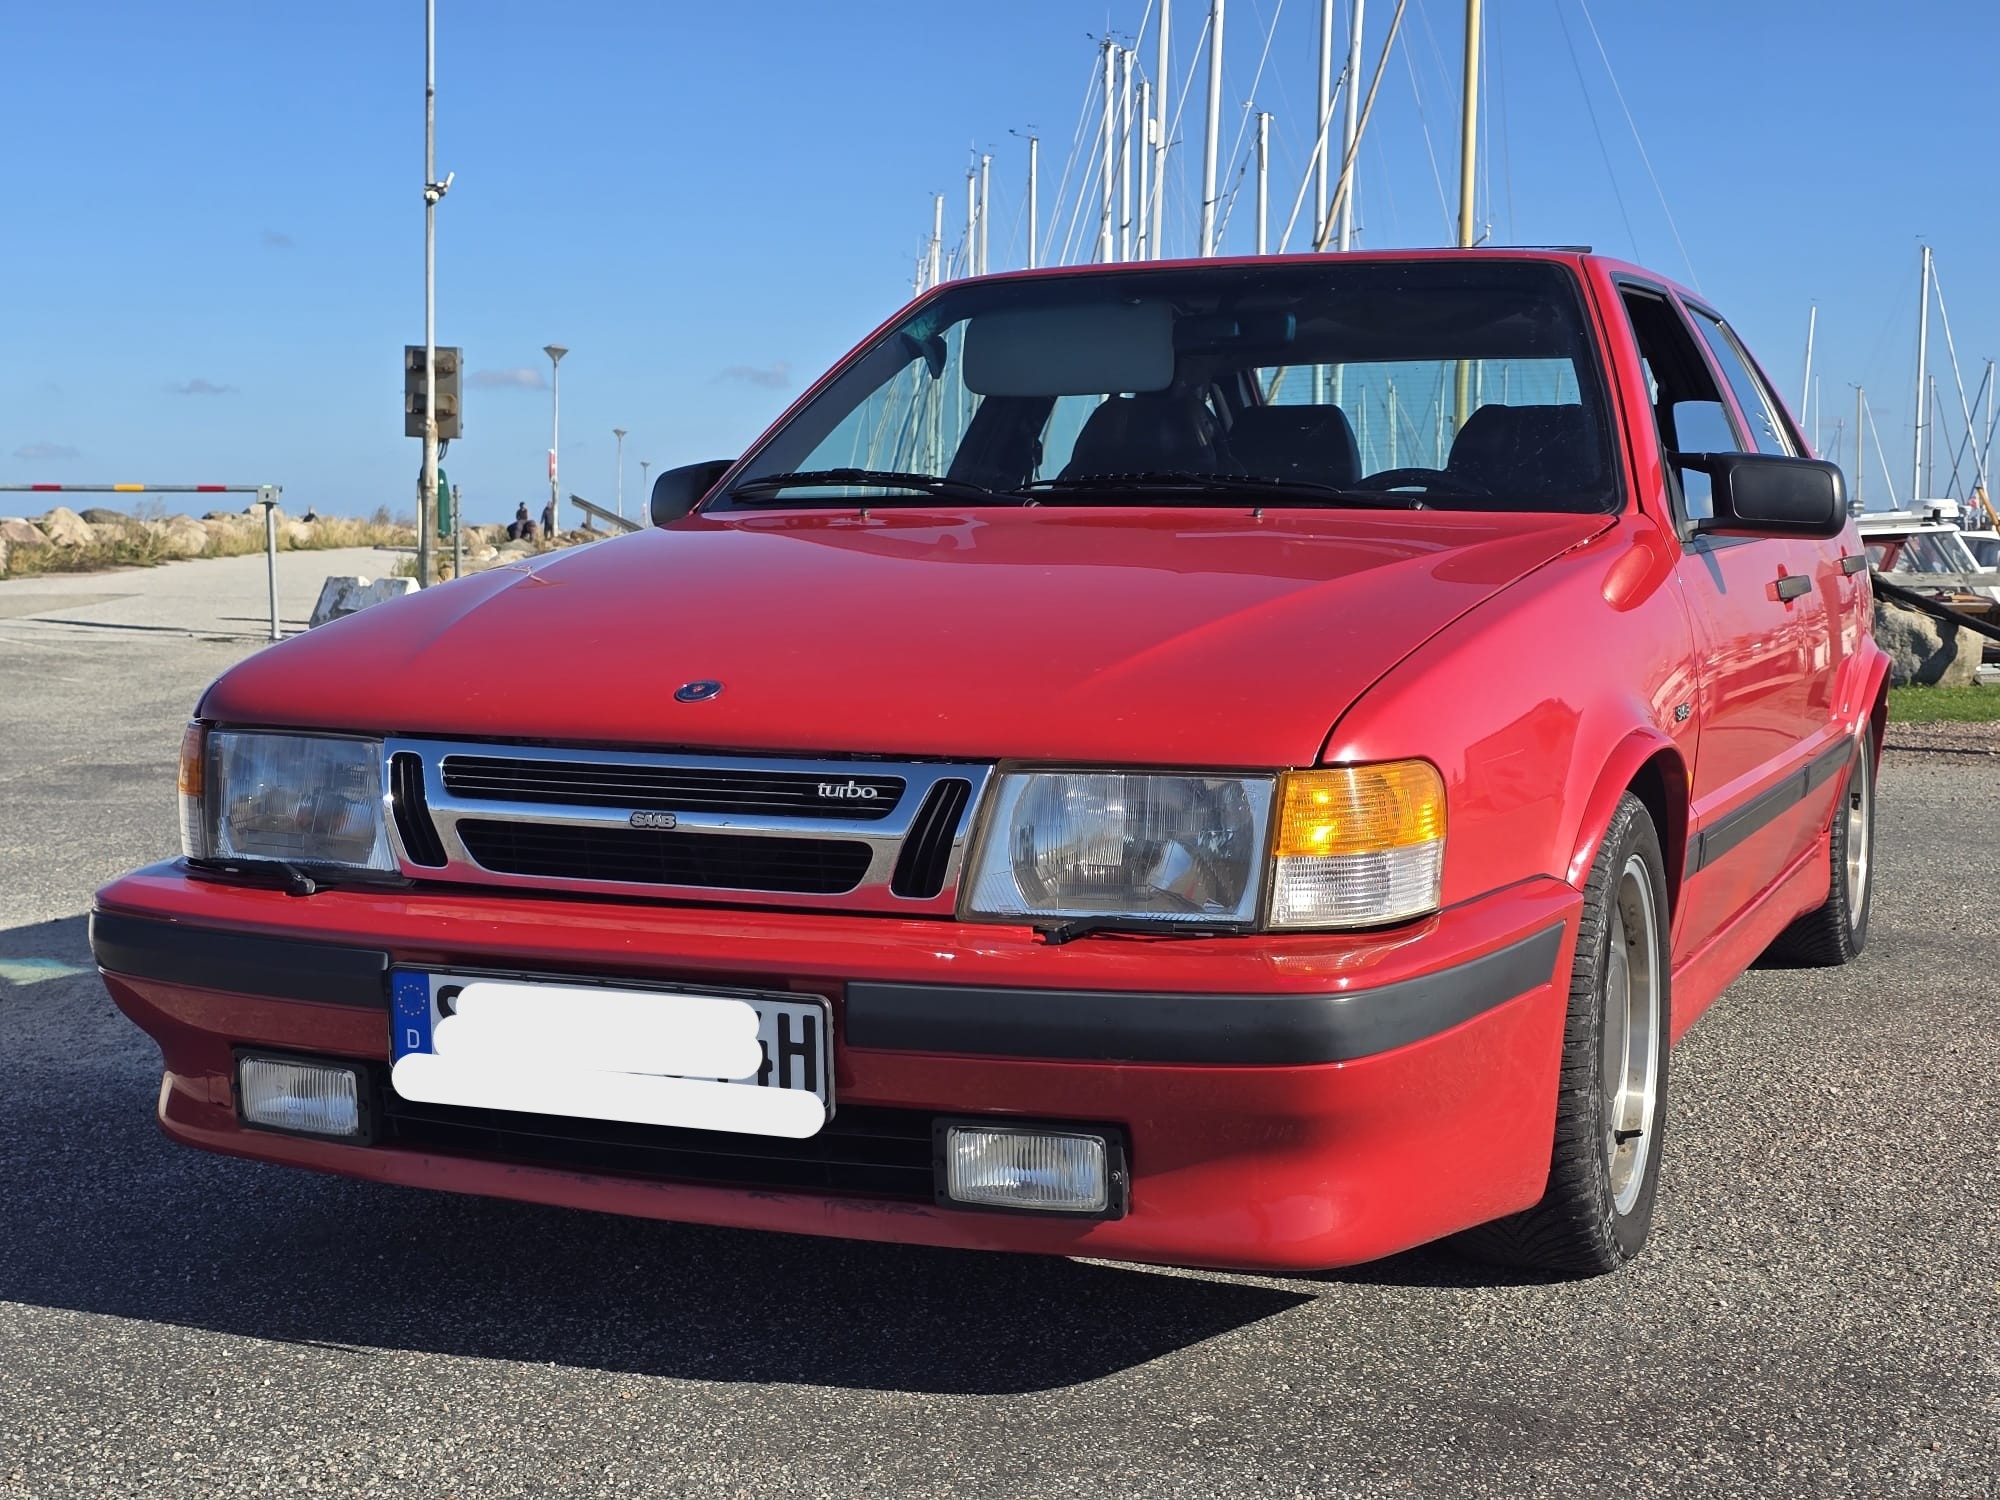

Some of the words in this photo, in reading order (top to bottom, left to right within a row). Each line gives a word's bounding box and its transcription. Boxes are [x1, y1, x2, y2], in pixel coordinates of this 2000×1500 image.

[818, 780, 878, 799] turbo
[630, 812, 676, 829] SAAB
[406, 1028, 420, 1049] D
